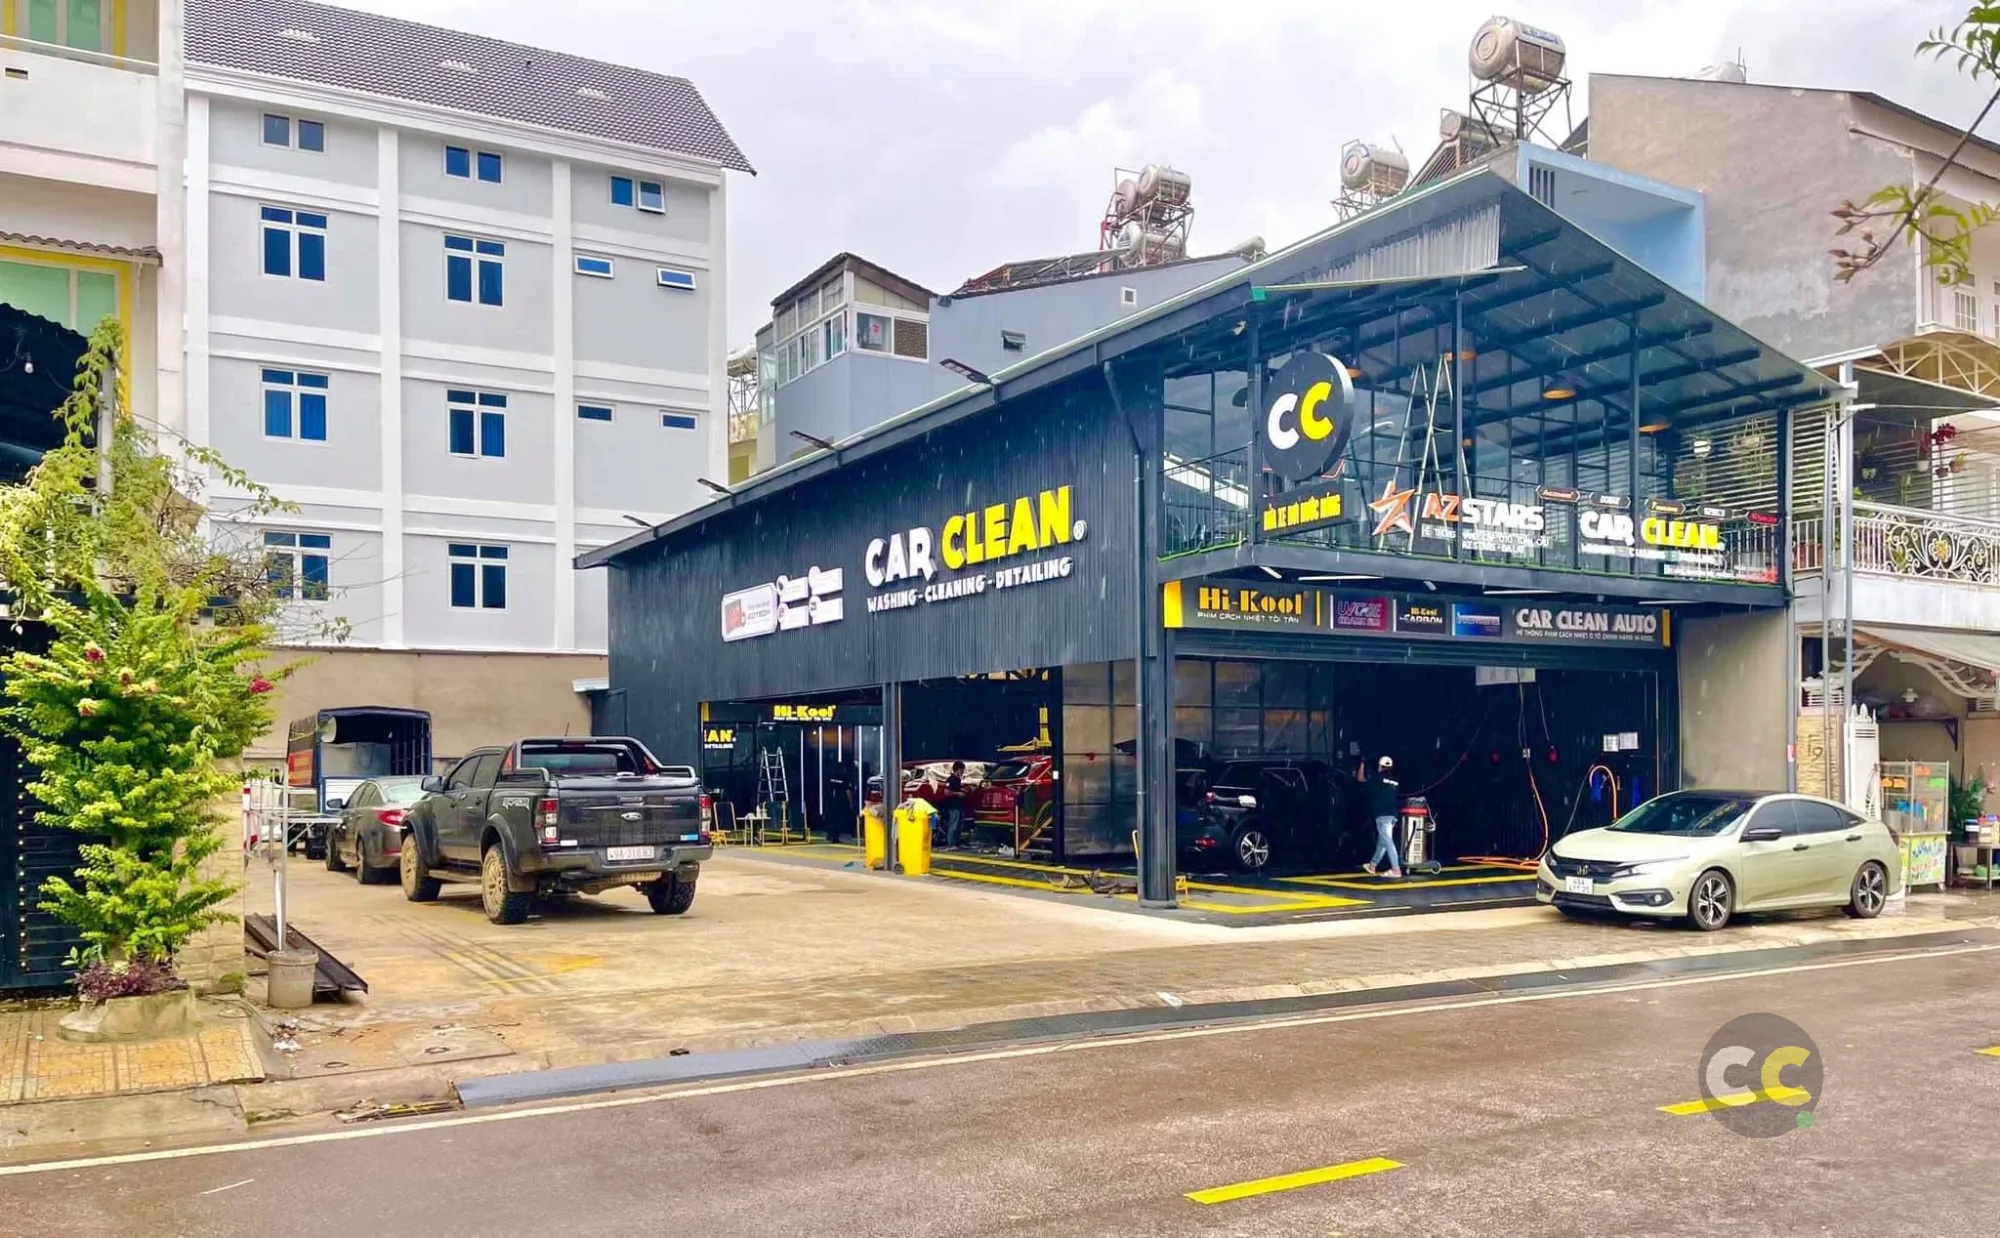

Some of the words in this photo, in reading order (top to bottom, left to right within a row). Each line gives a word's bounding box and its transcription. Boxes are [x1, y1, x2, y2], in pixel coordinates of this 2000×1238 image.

[1268, 381, 1334, 450] CC
[1579, 511, 1635, 545] CAR
[865, 527, 937, 587] CAR
[867, 588, 917, 613] WASHING
[924, 574, 987, 603] CLEANING
[995, 556, 1073, 589] DETAILING
[1198, 586, 1302, 615] Hi-Kool
[1197, 611, 1217, 619] PHIM
[1515, 608, 1553, 628] CAR
[1555, 610, 1609, 632] CLEAN
[1612, 613, 1657, 634] AUTO
